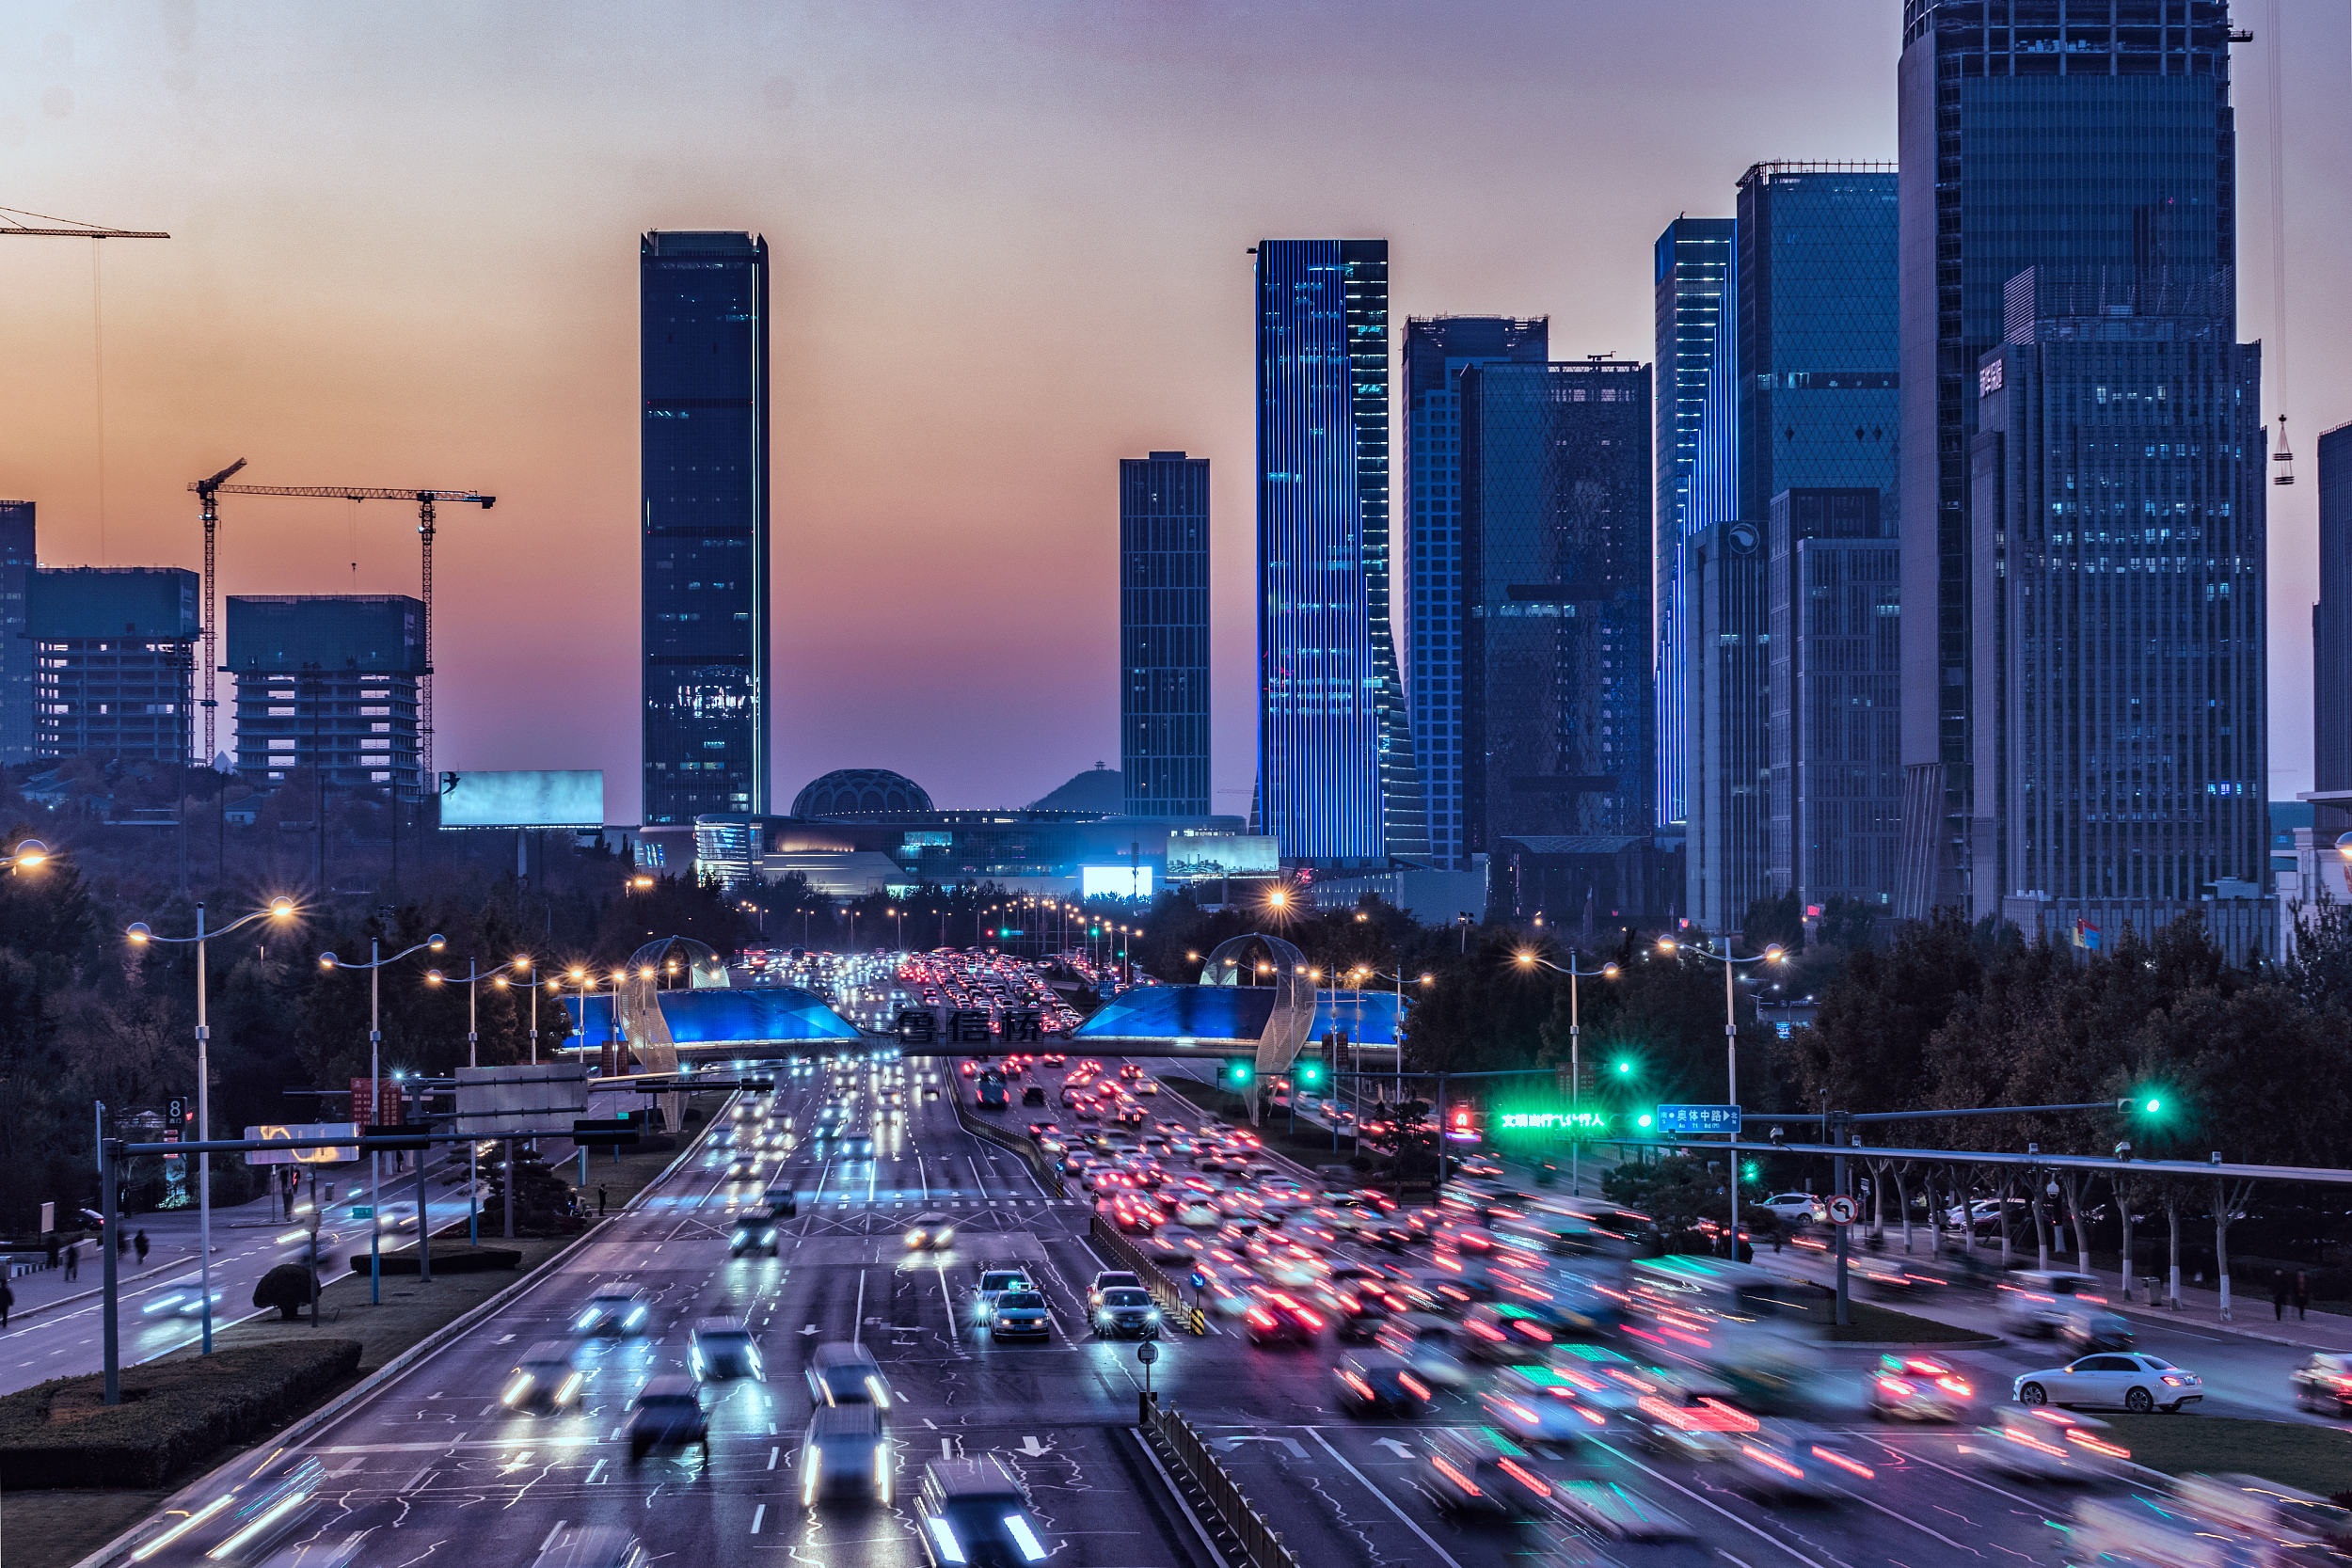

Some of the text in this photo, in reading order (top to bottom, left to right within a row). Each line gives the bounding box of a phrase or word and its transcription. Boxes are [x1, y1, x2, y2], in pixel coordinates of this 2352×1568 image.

[897, 1010, 1042, 1041] 鲁信桥
[170, 1101, 181, 1117] 8
[1677, 1110, 1722, 1121] 奥体中路
